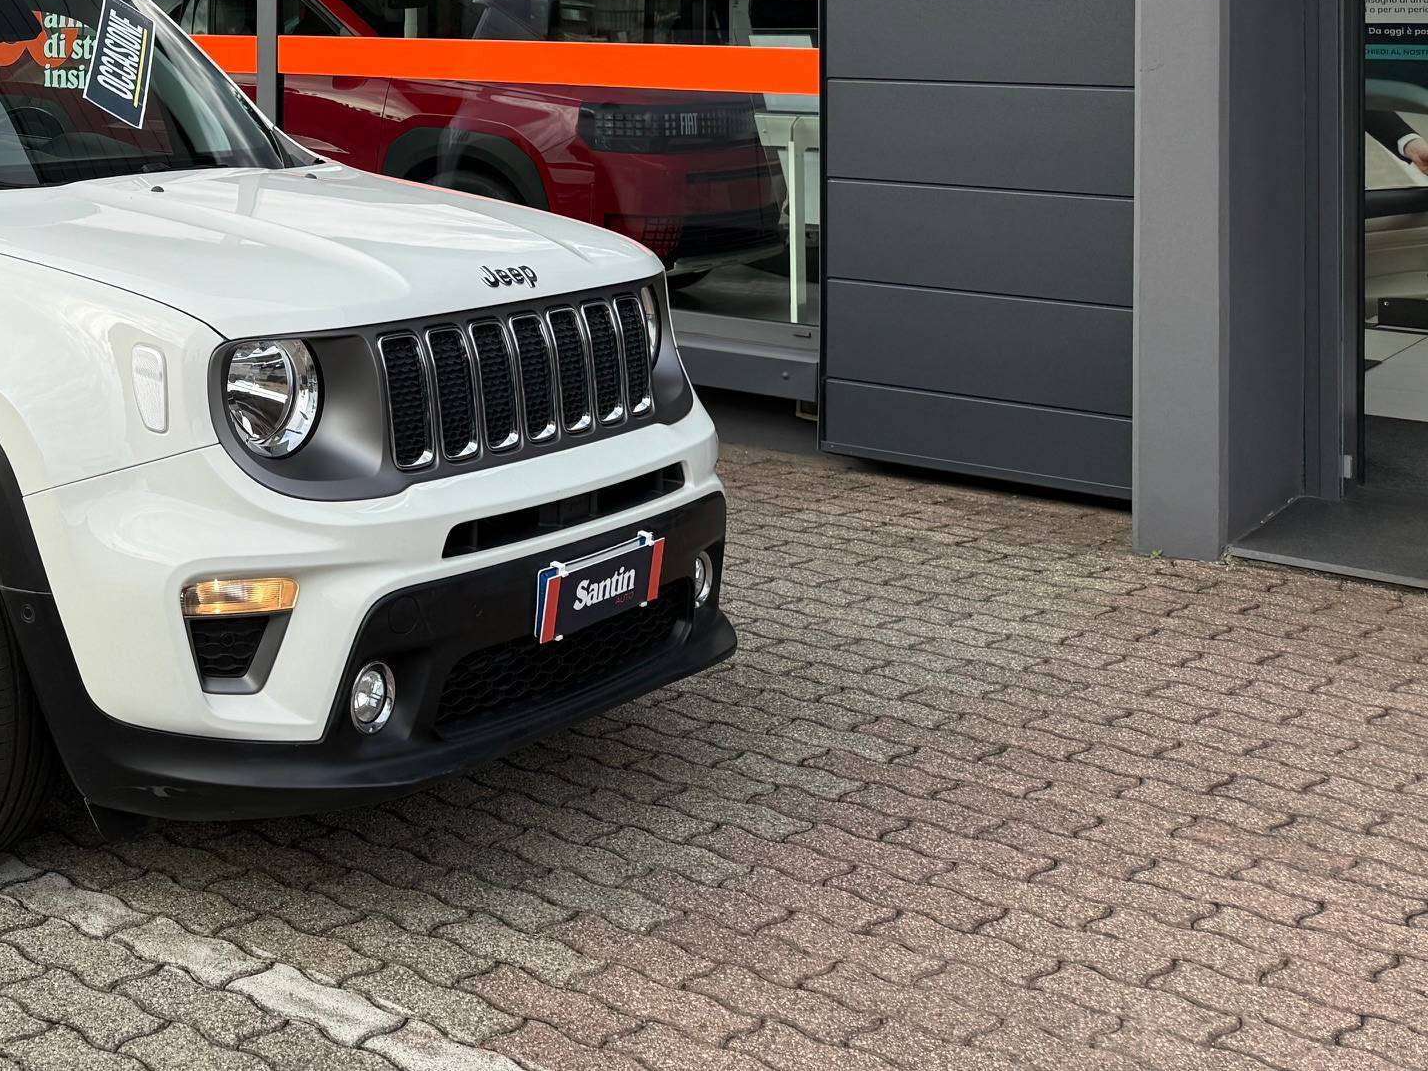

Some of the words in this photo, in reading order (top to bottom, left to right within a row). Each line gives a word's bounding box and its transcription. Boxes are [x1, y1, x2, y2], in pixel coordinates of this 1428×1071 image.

[43, 33, 67, 58] di
[96, 8, 144, 101] OCCASIONE
[679, 112, 699, 136] FIAT
[479, 263, 539, 289] Jeep
[573, 566, 636, 610] Santin
